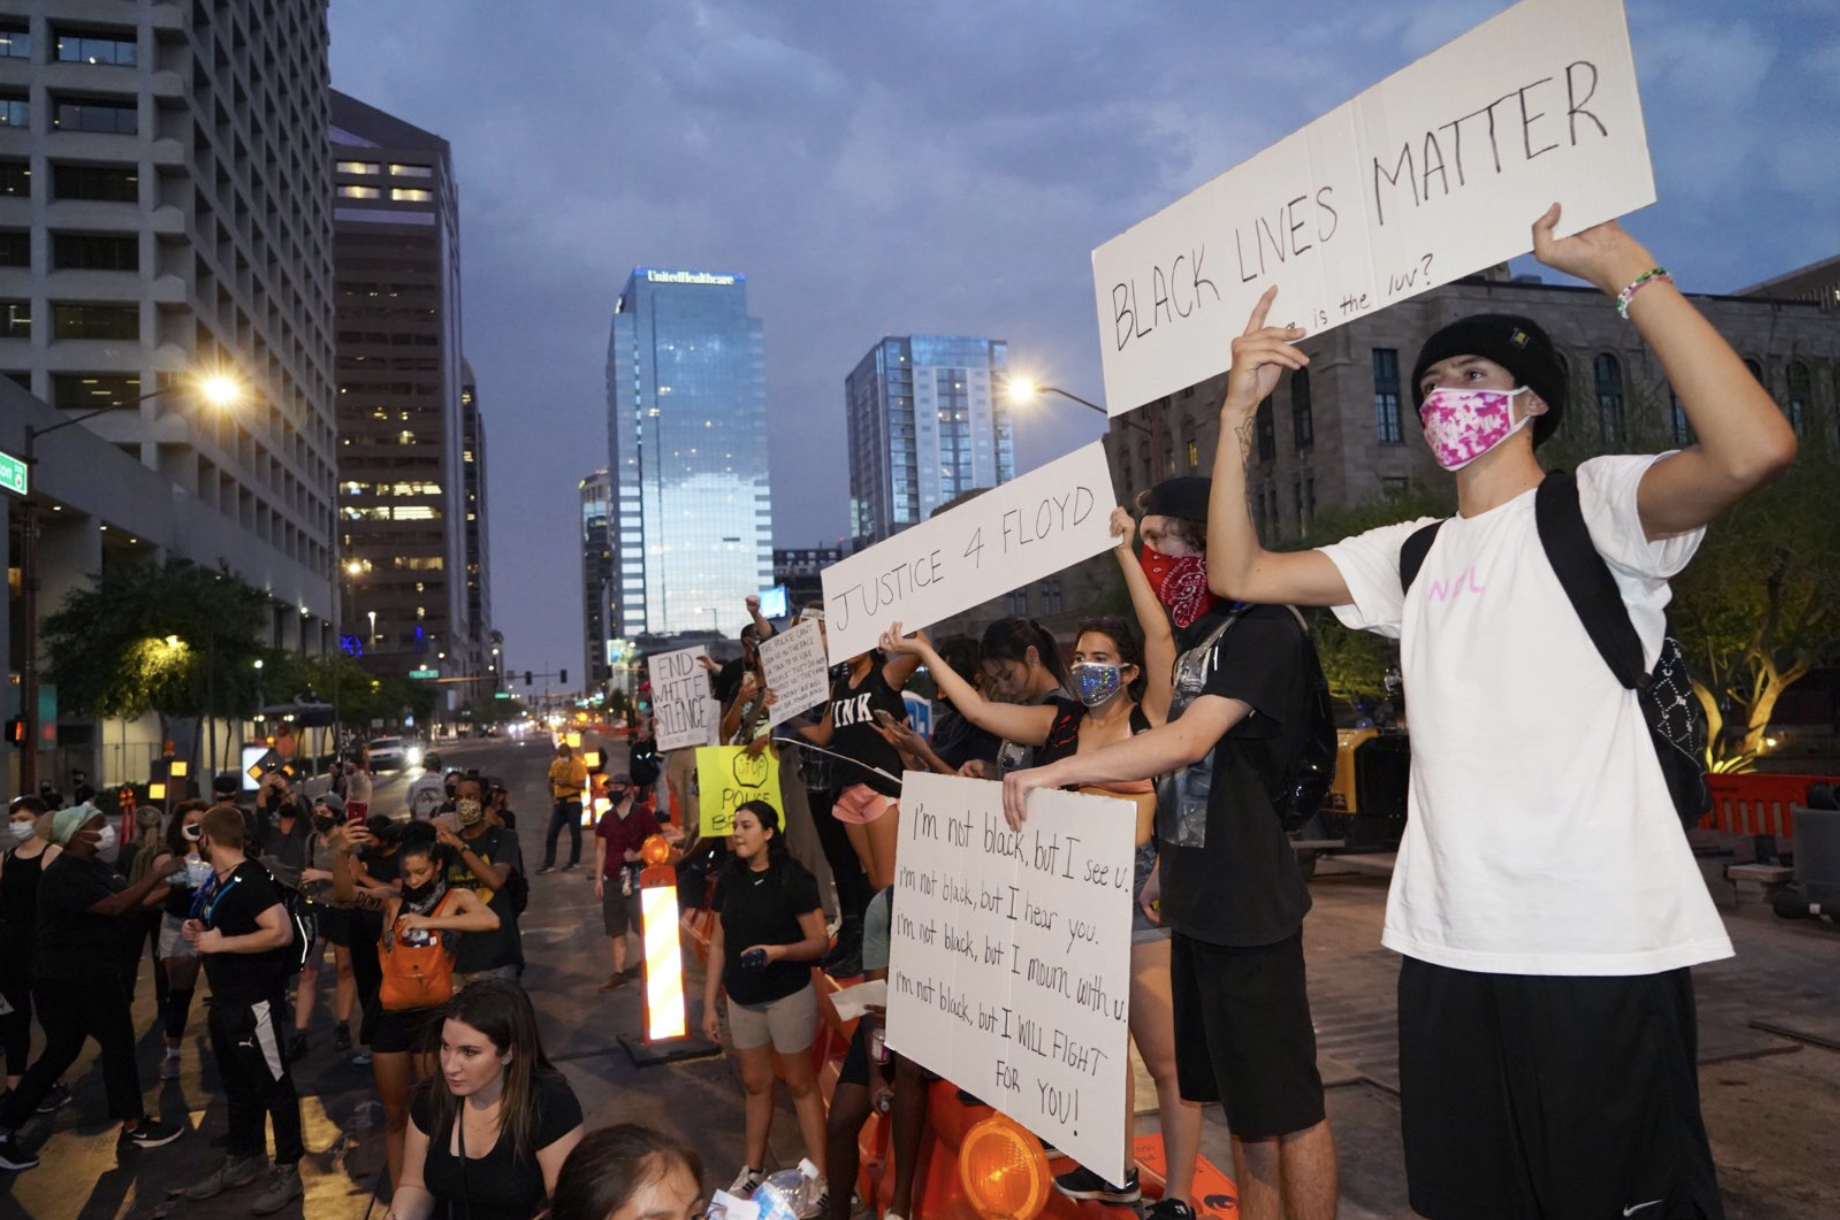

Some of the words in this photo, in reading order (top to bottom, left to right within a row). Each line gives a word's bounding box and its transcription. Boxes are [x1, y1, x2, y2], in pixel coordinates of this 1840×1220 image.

[1112, 243, 1220, 351] BLACK
[1236, 186, 1337, 282] LIVES
[1373, 60, 1608, 226] MATTER
[647, 269, 734, 285] UnitedHealthcare
[1314, 309, 1328, 328] is
[1340, 293, 1371, 316] the
[1388, 252, 1434, 296] luv?
[832, 549, 944, 631] JUSTICE
[964, 527, 985, 569] 4
[1003, 486, 1095, 554] FLOYD
[651, 674, 706, 704] WHITE
[658, 652, 693, 680] END
[655, 695, 708, 736] SILENCE
[831, 692, 874, 728] INK
[948, 809, 974, 848] not
[1034, 829, 1060, 875] but
[1062, 836, 1081, 880] I
[1084, 859, 1109, 886] see
[920, 870, 938, 898] not
[942, 872, 977, 911] black,
[980, 880, 1003, 914] but
[1006, 885, 1020, 920] I
[1025, 889, 1059, 931] hear
[1067, 918, 1098, 954] you.
[919, 919, 937, 945] not
[944, 922, 978, 962] black,
[984, 935, 1004, 965] but
[1011, 944, 1021, 975] I
[1027, 957, 1071, 999] mourn
[1076, 972, 1109, 1018] with
[916, 977, 936, 1005] not
[940, 981, 974, 1026] black,
[979, 1002, 1003, 1034] but
[1001, 1007, 1013, 1039] I
[1018, 1014, 1048, 1057] WILL
[1052, 1028, 1109, 1077] FIGHT
[996, 1060, 1021, 1094] FOR
[1037, 1078, 1080, 1137] YOU!
